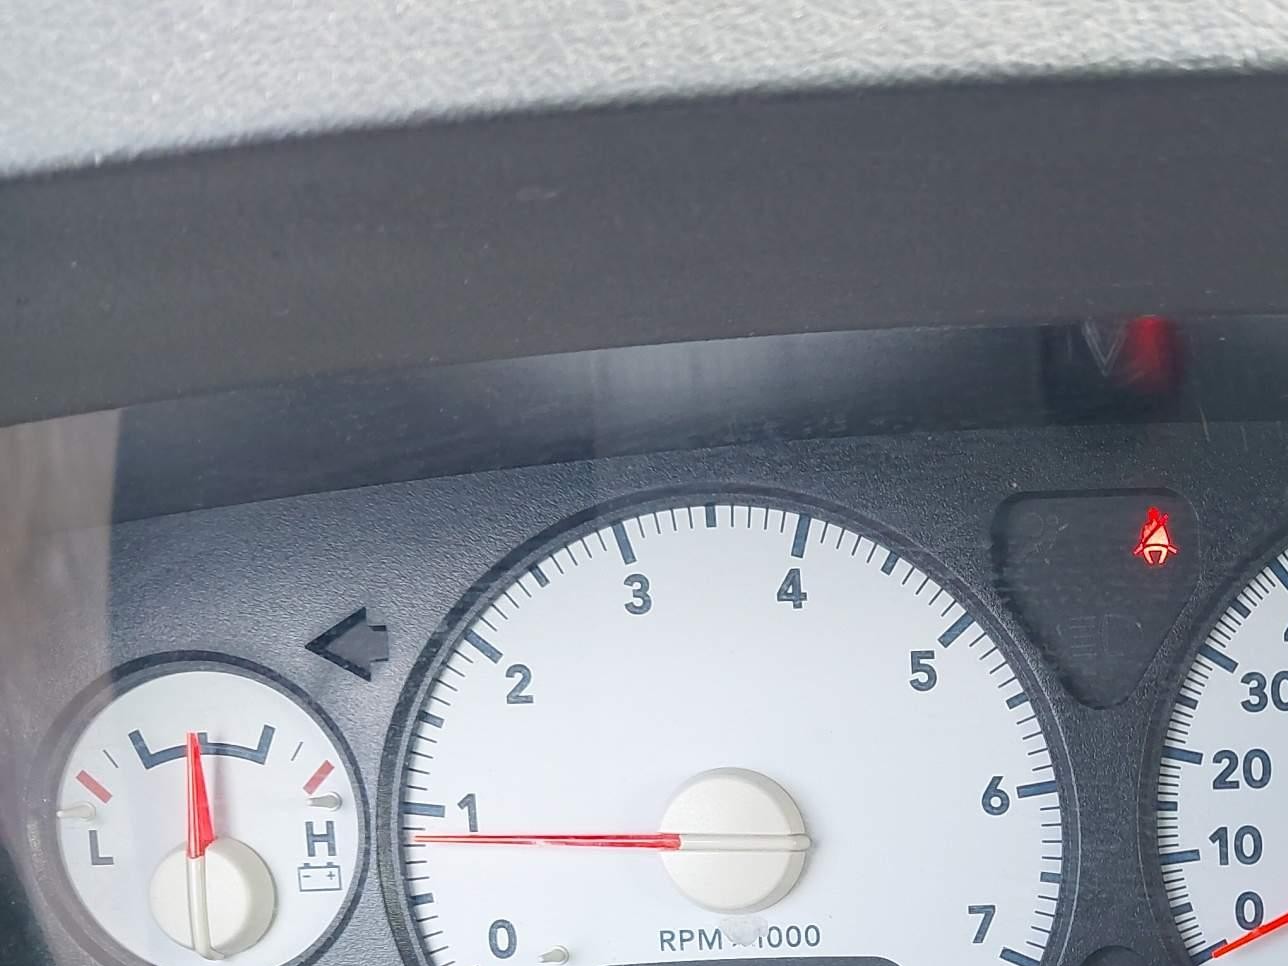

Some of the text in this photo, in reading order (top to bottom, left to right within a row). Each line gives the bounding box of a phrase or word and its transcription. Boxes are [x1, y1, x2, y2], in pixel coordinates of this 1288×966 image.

[624, 574, 651, 615] 3
[777, 568, 807, 609] 4
[506, 664, 533, 704] 2
[910, 650, 937, 691] 5
[1212, 749, 1271, 789] 20
[457, 793, 478, 832] 1
[982, 776, 1010, 815] 6
[89, 830, 114, 865] L
[305, 821, 336, 857] H
[1209, 825, 1262, 865] 10
[968, 905, 995, 943] 7
[1235, 891, 1264, 930] 0
[489, 919, 517, 959] 0
[660, 928, 722, 951] RPM
